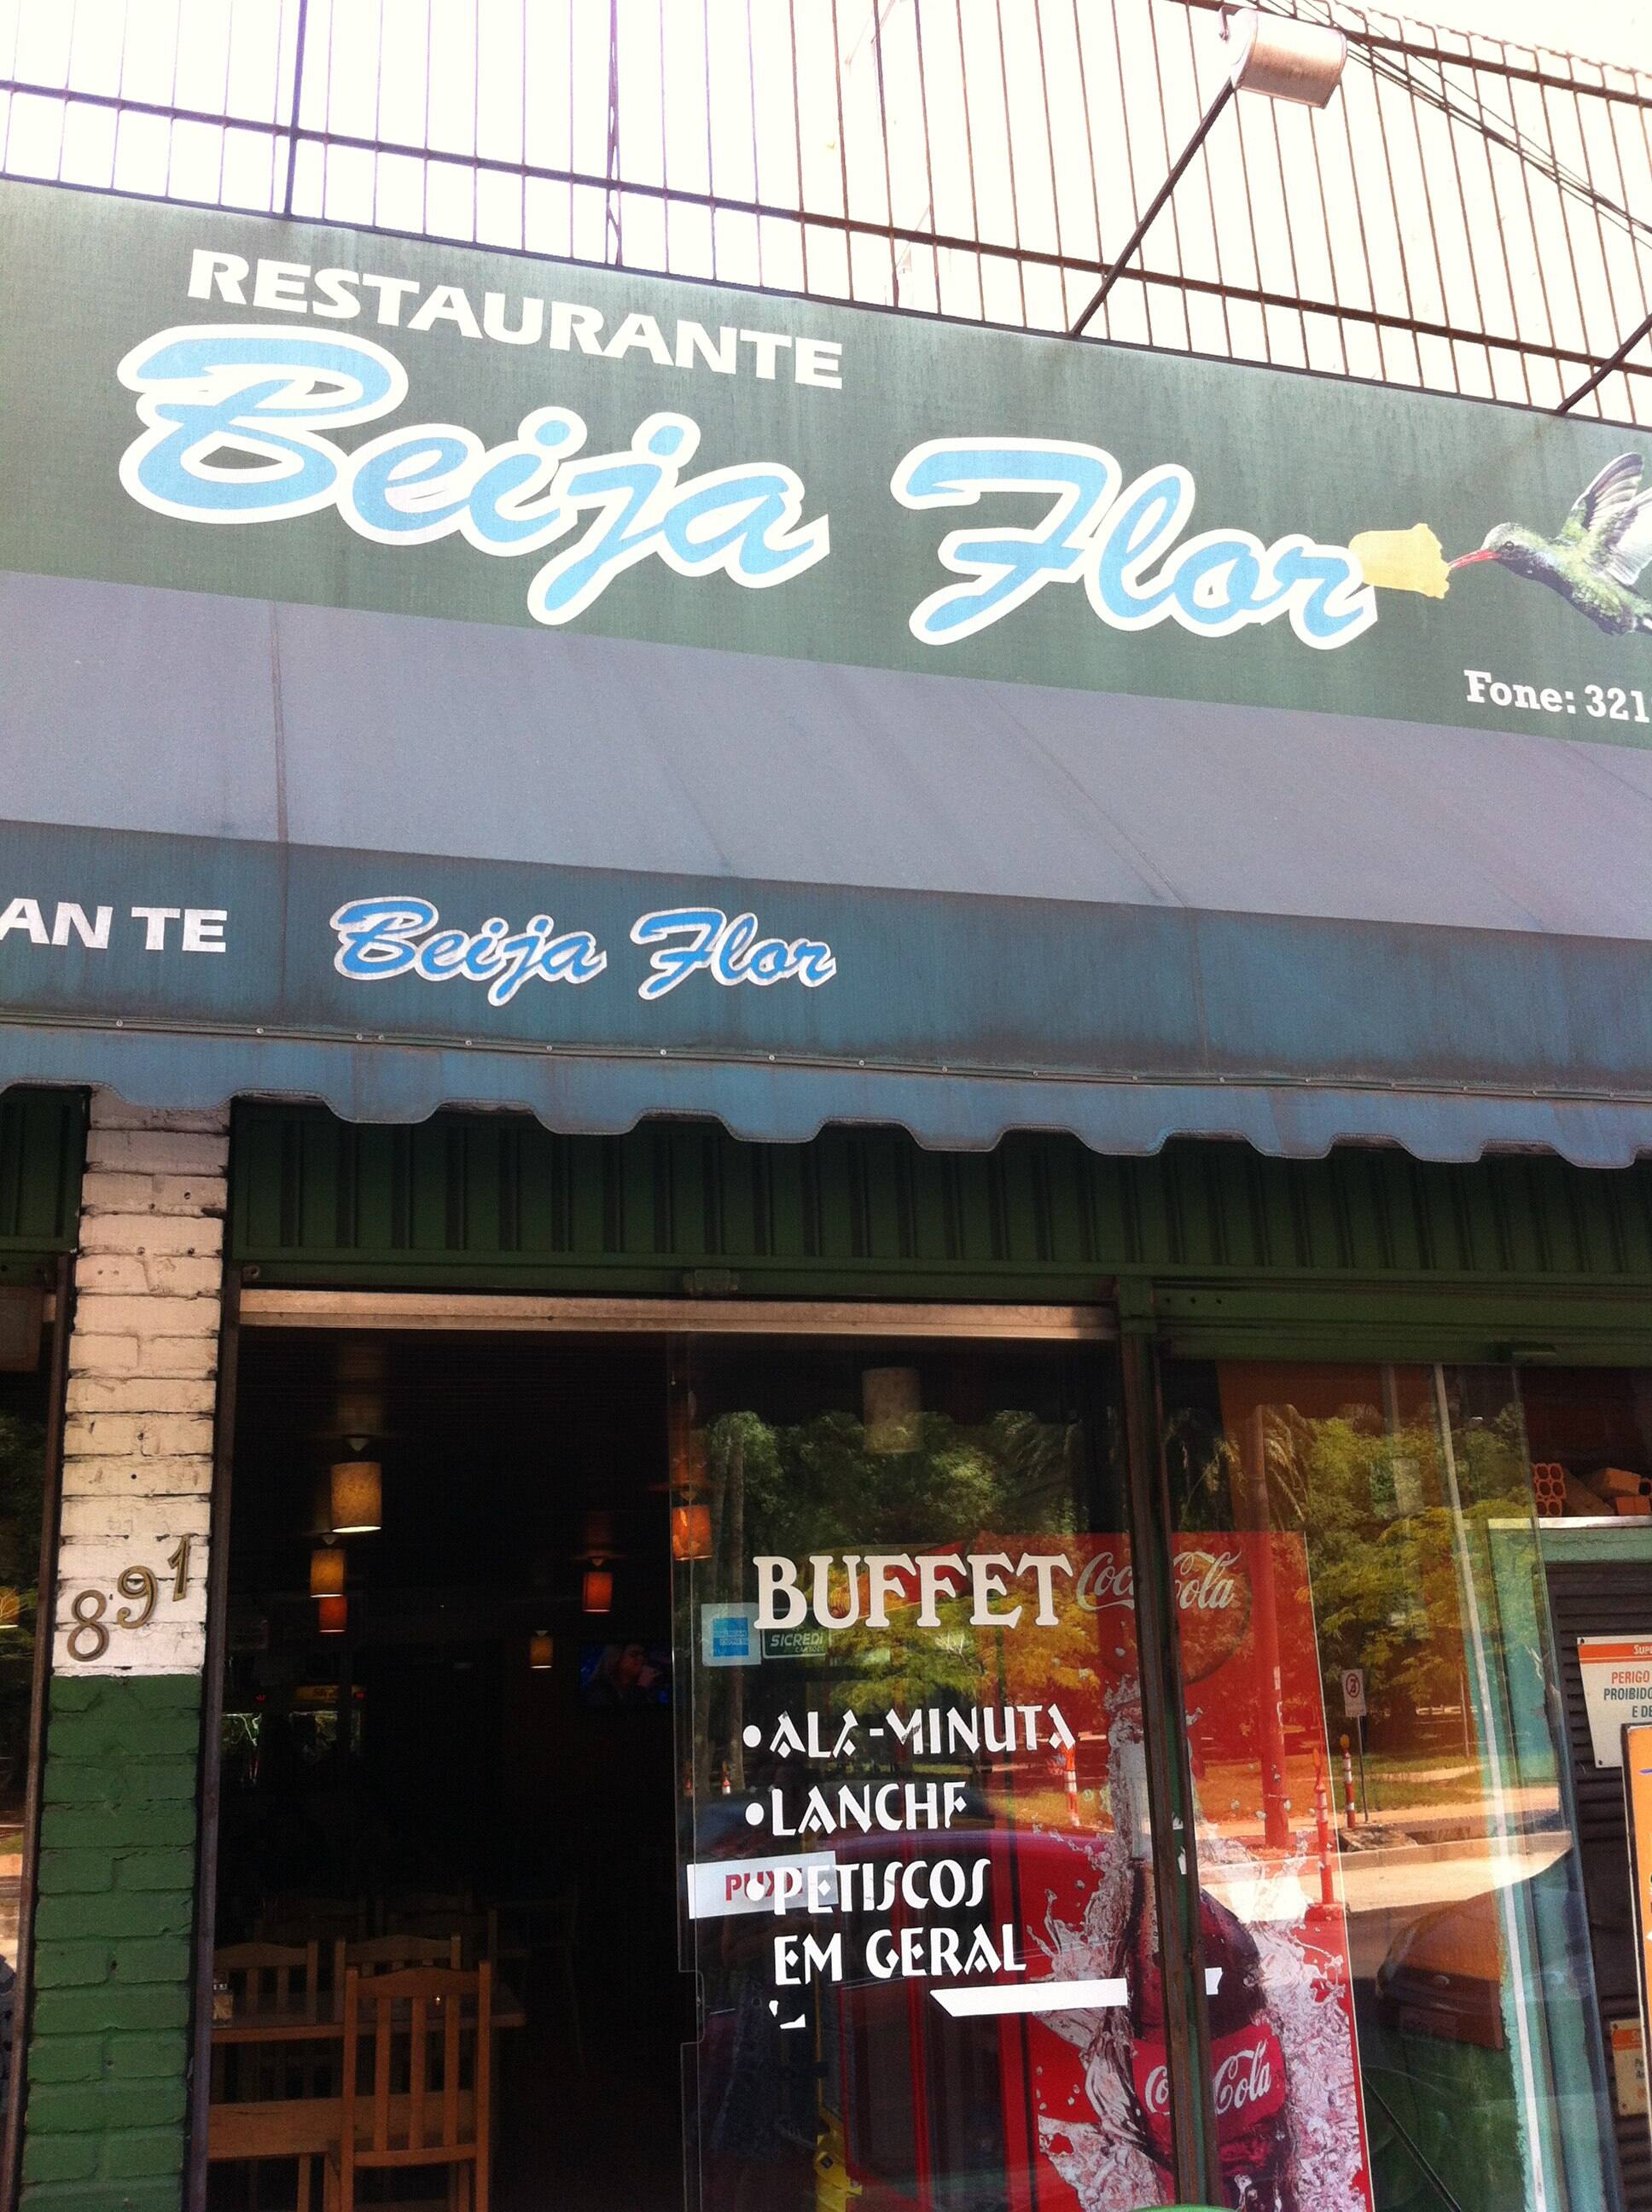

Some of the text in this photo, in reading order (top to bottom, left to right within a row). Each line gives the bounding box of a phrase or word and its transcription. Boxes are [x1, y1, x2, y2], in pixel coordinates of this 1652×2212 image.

[188, 249, 843, 390] RESTAURANTE
[117, 324, 1378, 649] Beija Flor
[1463, 669, 1576, 714] Fone:
[330, 894, 608, 1007] Beija
[630, 906, 836, 1000] Flor
[67, 1533, 197, 1662] 891
[753, 1553, 1073, 1630] BUFFET
[1611, 1670, 1650, 1684] PERIGO
[1632, 1705, 1638, 1718] E
[773, 1858, 992, 1916] PETISCOS
[774, 1923, 1027, 1986] EM GERAL
